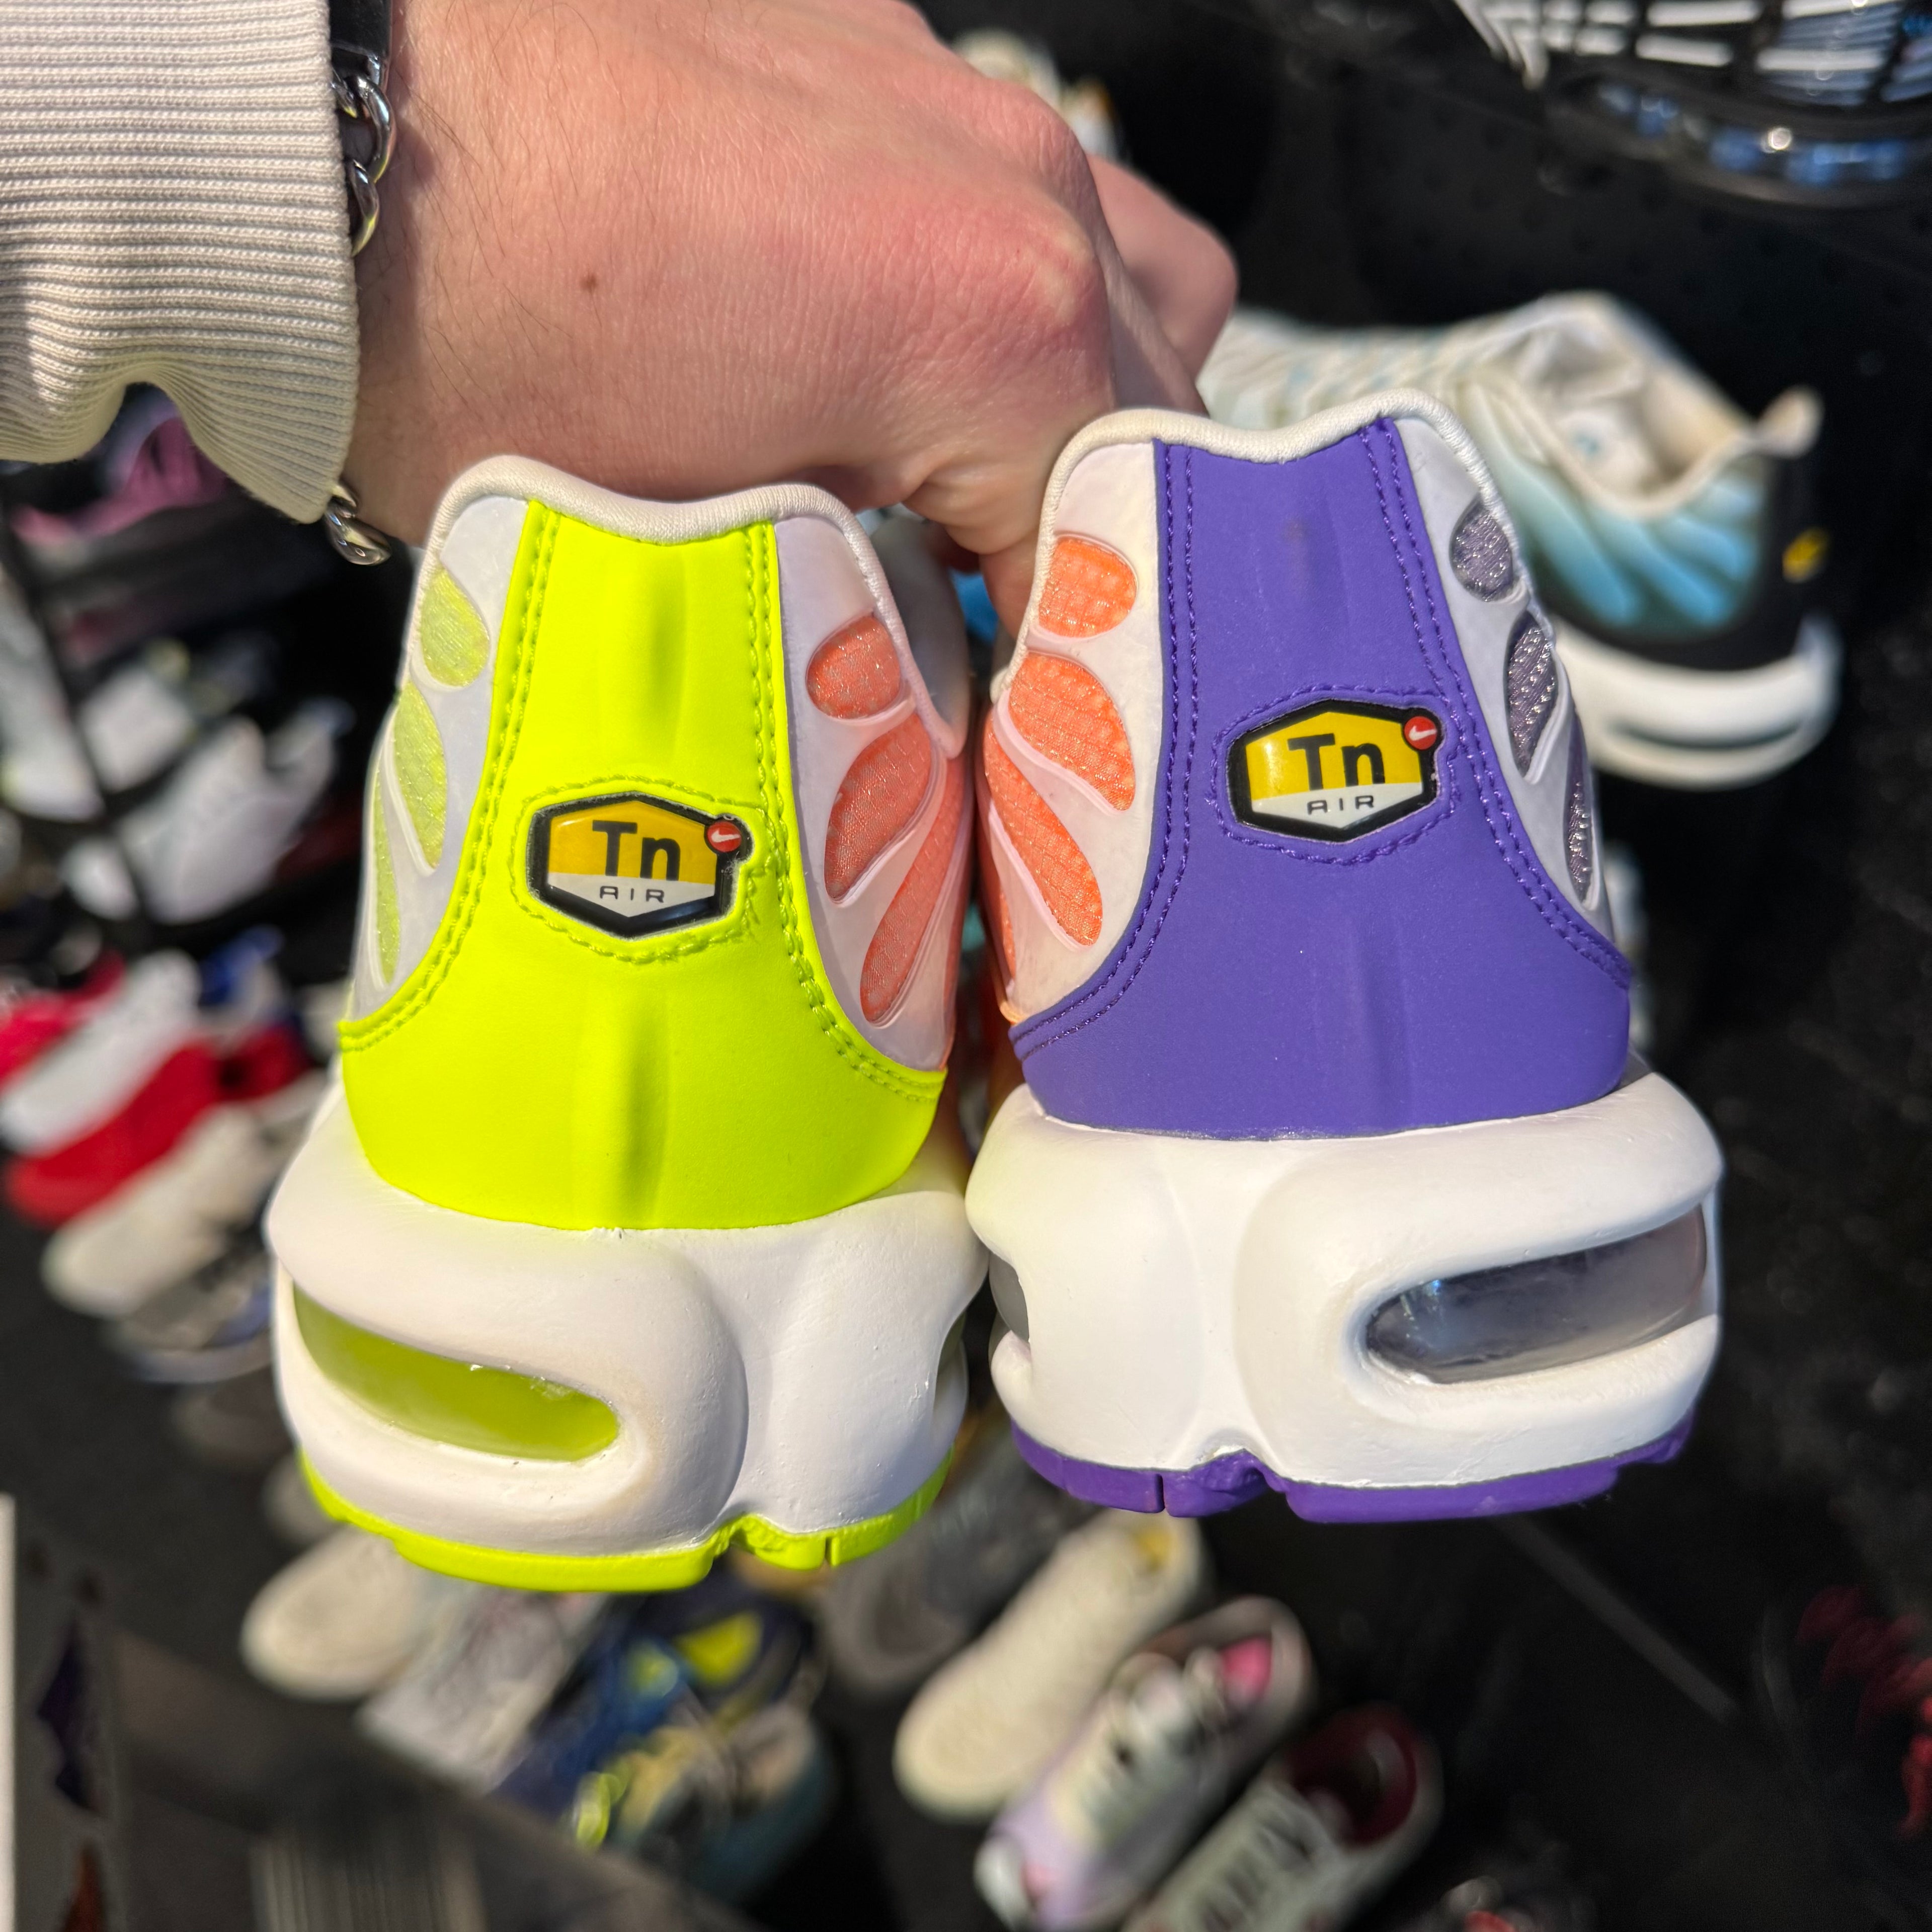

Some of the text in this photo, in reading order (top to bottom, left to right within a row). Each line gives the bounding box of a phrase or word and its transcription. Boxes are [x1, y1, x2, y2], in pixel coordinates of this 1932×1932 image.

[1287, 733, 1386, 791] Tn
[1307, 795, 1375, 815] AIR
[592, 820, 681, 881] Tn
[599, 886, 665, 903] AIR
